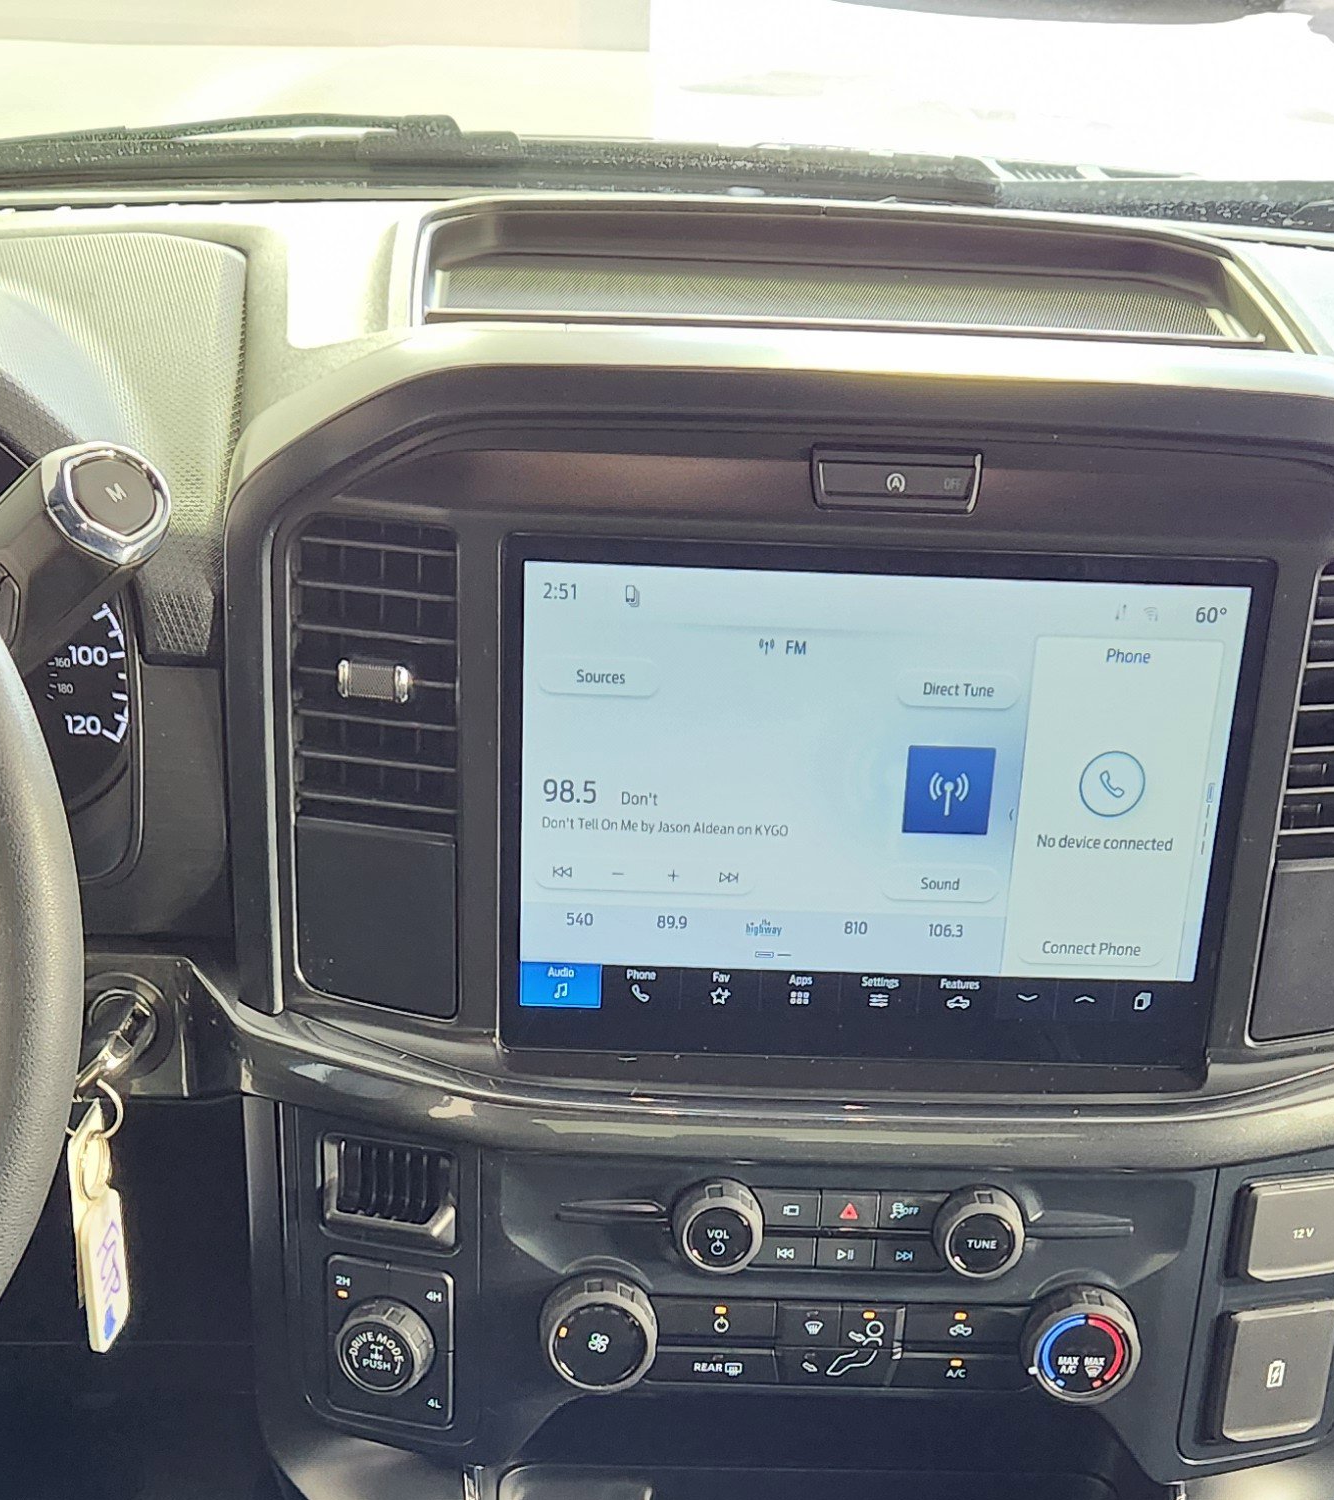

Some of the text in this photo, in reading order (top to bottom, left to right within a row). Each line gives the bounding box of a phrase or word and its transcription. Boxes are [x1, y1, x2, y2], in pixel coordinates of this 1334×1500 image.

[543, 582, 578, 601] 2:51
[785, 640, 807, 656] FM
[55, 656, 70, 668] 160
[69, 645, 109, 667] 100
[1106, 648, 1151, 665] Phone
[576, 669, 626, 685] Sources
[57, 683, 74, 694] 180
[923, 682, 995, 698] Direct Tune
[64, 714, 101, 736] 120
[543, 778, 597, 804] 98.5
[621, 790, 658, 806] Don't
[542, 816, 789, 837] Don't Tell On Me by Jason Aldean on KYGO
[1037, 834, 1174, 852] No device connected
[920, 877, 960, 892] Sound
[566, 912, 594, 927] 540
[656, 915, 688, 930] 89.9
[746, 923, 783, 937] highway
[843, 921, 868, 936] 810
[928, 923, 964, 938] 106.3
[1042, 940, 1141, 957] Connect Phone
[547, 966, 575, 979] Audio
[626, 968, 657, 982] Phone
[712, 971, 731, 984] Fav
[789, 974, 814, 988] Apps
[861, 976, 900, 990] Settings
[939, 978, 980, 991] Features
[903, 1206, 919, 1216] OFF
[706, 1228, 729, 1240] VOL
[967, 1239, 997, 1250] TUNE
[335, 1275, 351, 1286] 2H
[426, 1291, 442, 1302] 4H
[348, 1331, 405, 1362] DRIVE MODE
[362, 1358, 391, 1371] PUSH
[693, 1362, 723, 1373] REAR
[1057, 1356, 1080, 1365] MAX
[1084, 1356, 1106, 1366] MAX
[945, 1368, 966, 1379] A/C
[1059, 1365, 1077, 1374] A/C
[427, 1398, 442, 1409] 4L
